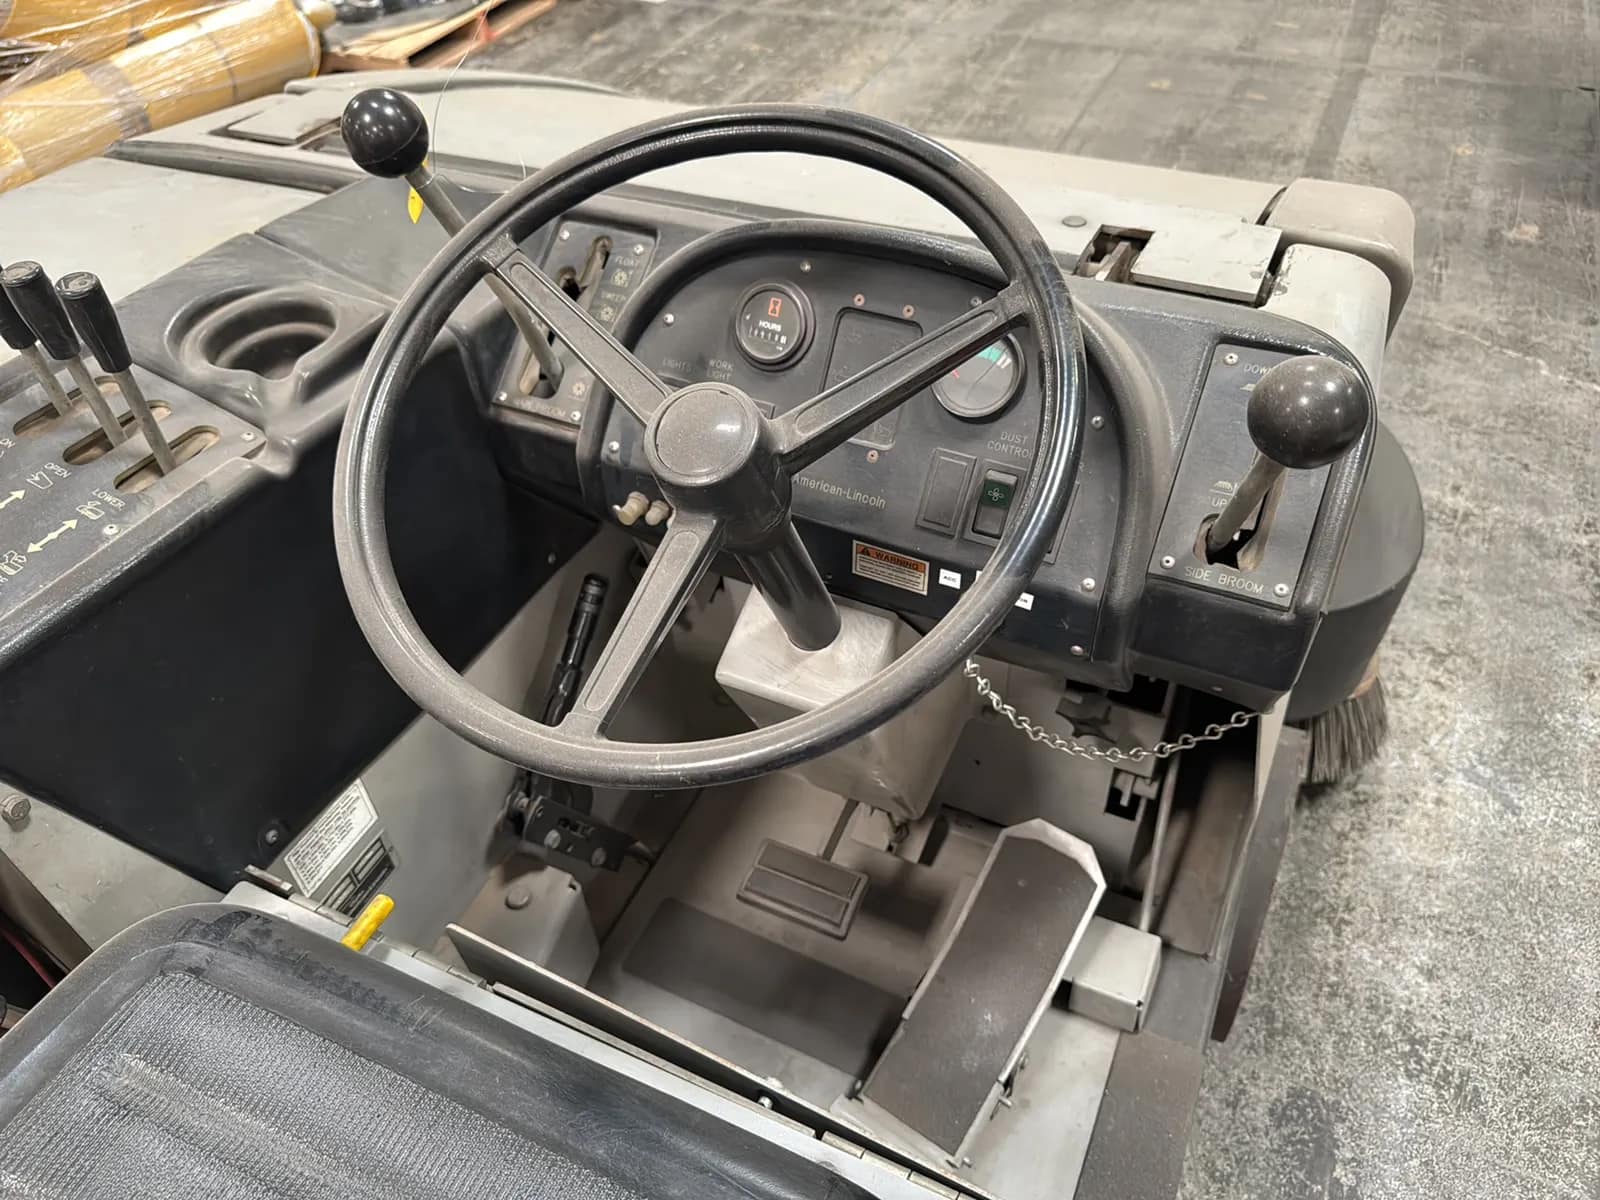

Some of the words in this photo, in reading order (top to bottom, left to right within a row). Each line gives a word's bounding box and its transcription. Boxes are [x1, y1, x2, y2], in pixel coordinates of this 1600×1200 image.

[758, 319, 783, 333] HOURS
[708, 359, 734, 372] WORK
[999, 431, 1028, 443] DUST
[44, 461, 72, 479] OPEN
[91, 487, 126, 511] LOWER
[790, 472, 886, 510] American-Lincoln
[1211, 496, 1227, 507] UP
[874, 550, 919, 570] WARNING
[1184, 565, 1213, 582] SIDE
[1217, 573, 1265, 594] BROOM
